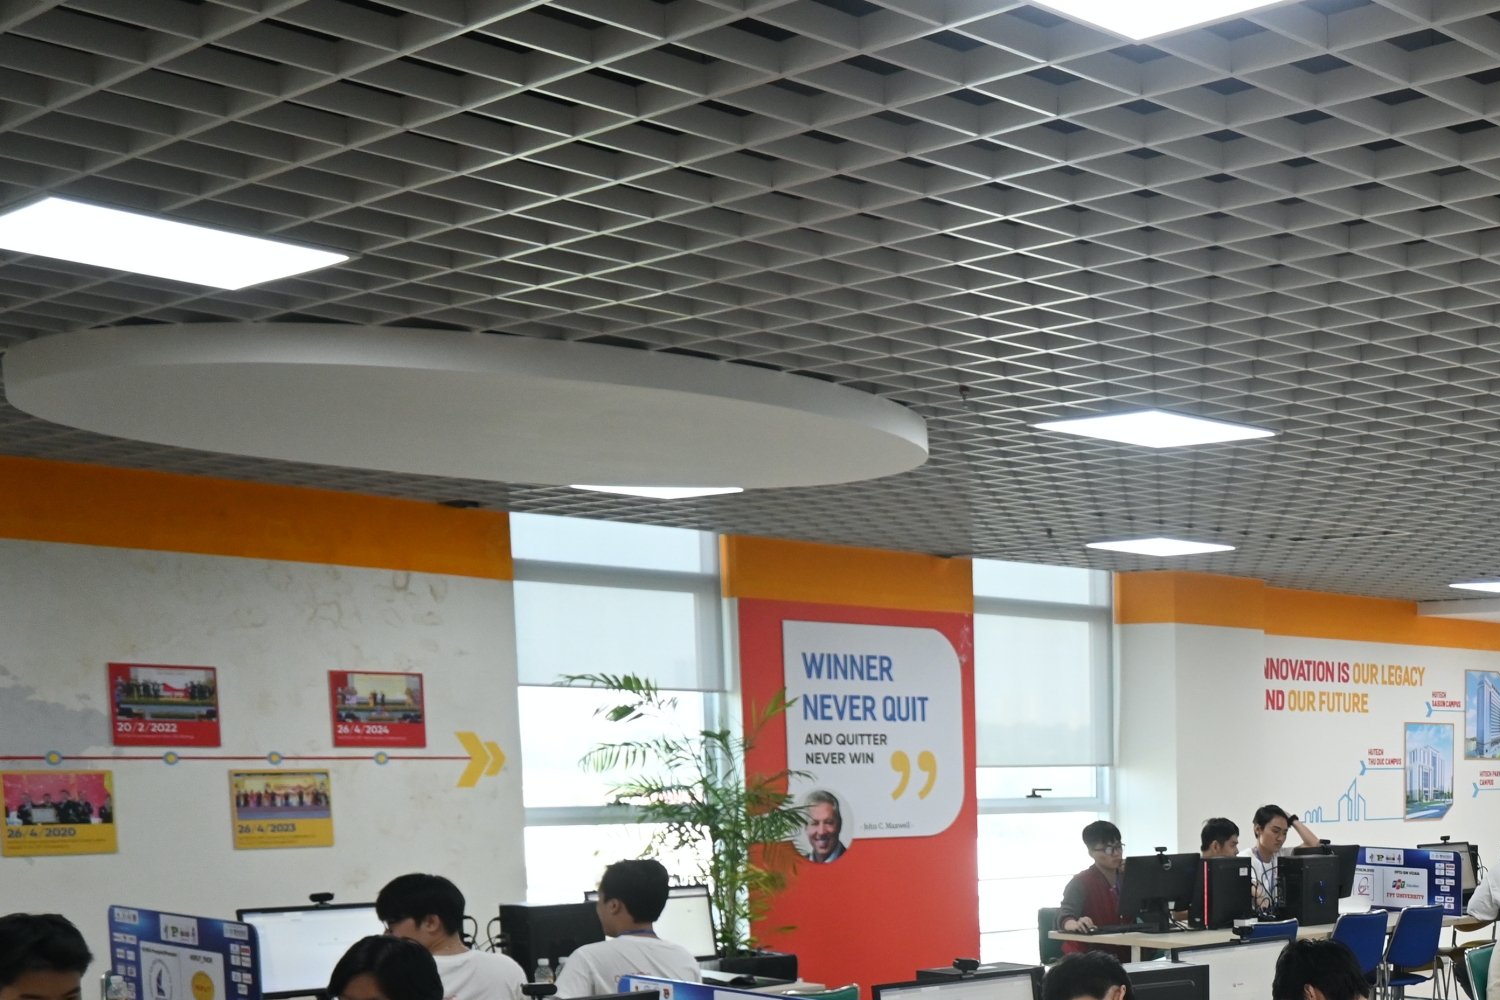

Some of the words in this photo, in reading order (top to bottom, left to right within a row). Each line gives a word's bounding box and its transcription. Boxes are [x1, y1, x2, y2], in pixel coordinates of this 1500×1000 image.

[802, 652, 894, 681] WINNER
[1338, 662, 1350, 682] IS
[1353, 663, 1379, 685] OUR
[1381, 665, 1426, 686] LEGACY
[802, 694, 877, 721] NEVER
[882, 696, 929, 722] QUIT
[1264, 689, 1285, 710] ND
[1288, 690, 1316, 712] OUR
[1318, 691, 1369, 713] FUTURE
[804, 733, 833, 745] AND
[836, 733, 888, 745] QUITTER
[805, 752, 846, 764] NEVER
[849, 752, 875, 764] WIN
[863, 822, 878, 830] John
[886, 822, 911, 830] Maxwell
[1395, 892, 1425, 900] UNIVERSITY
